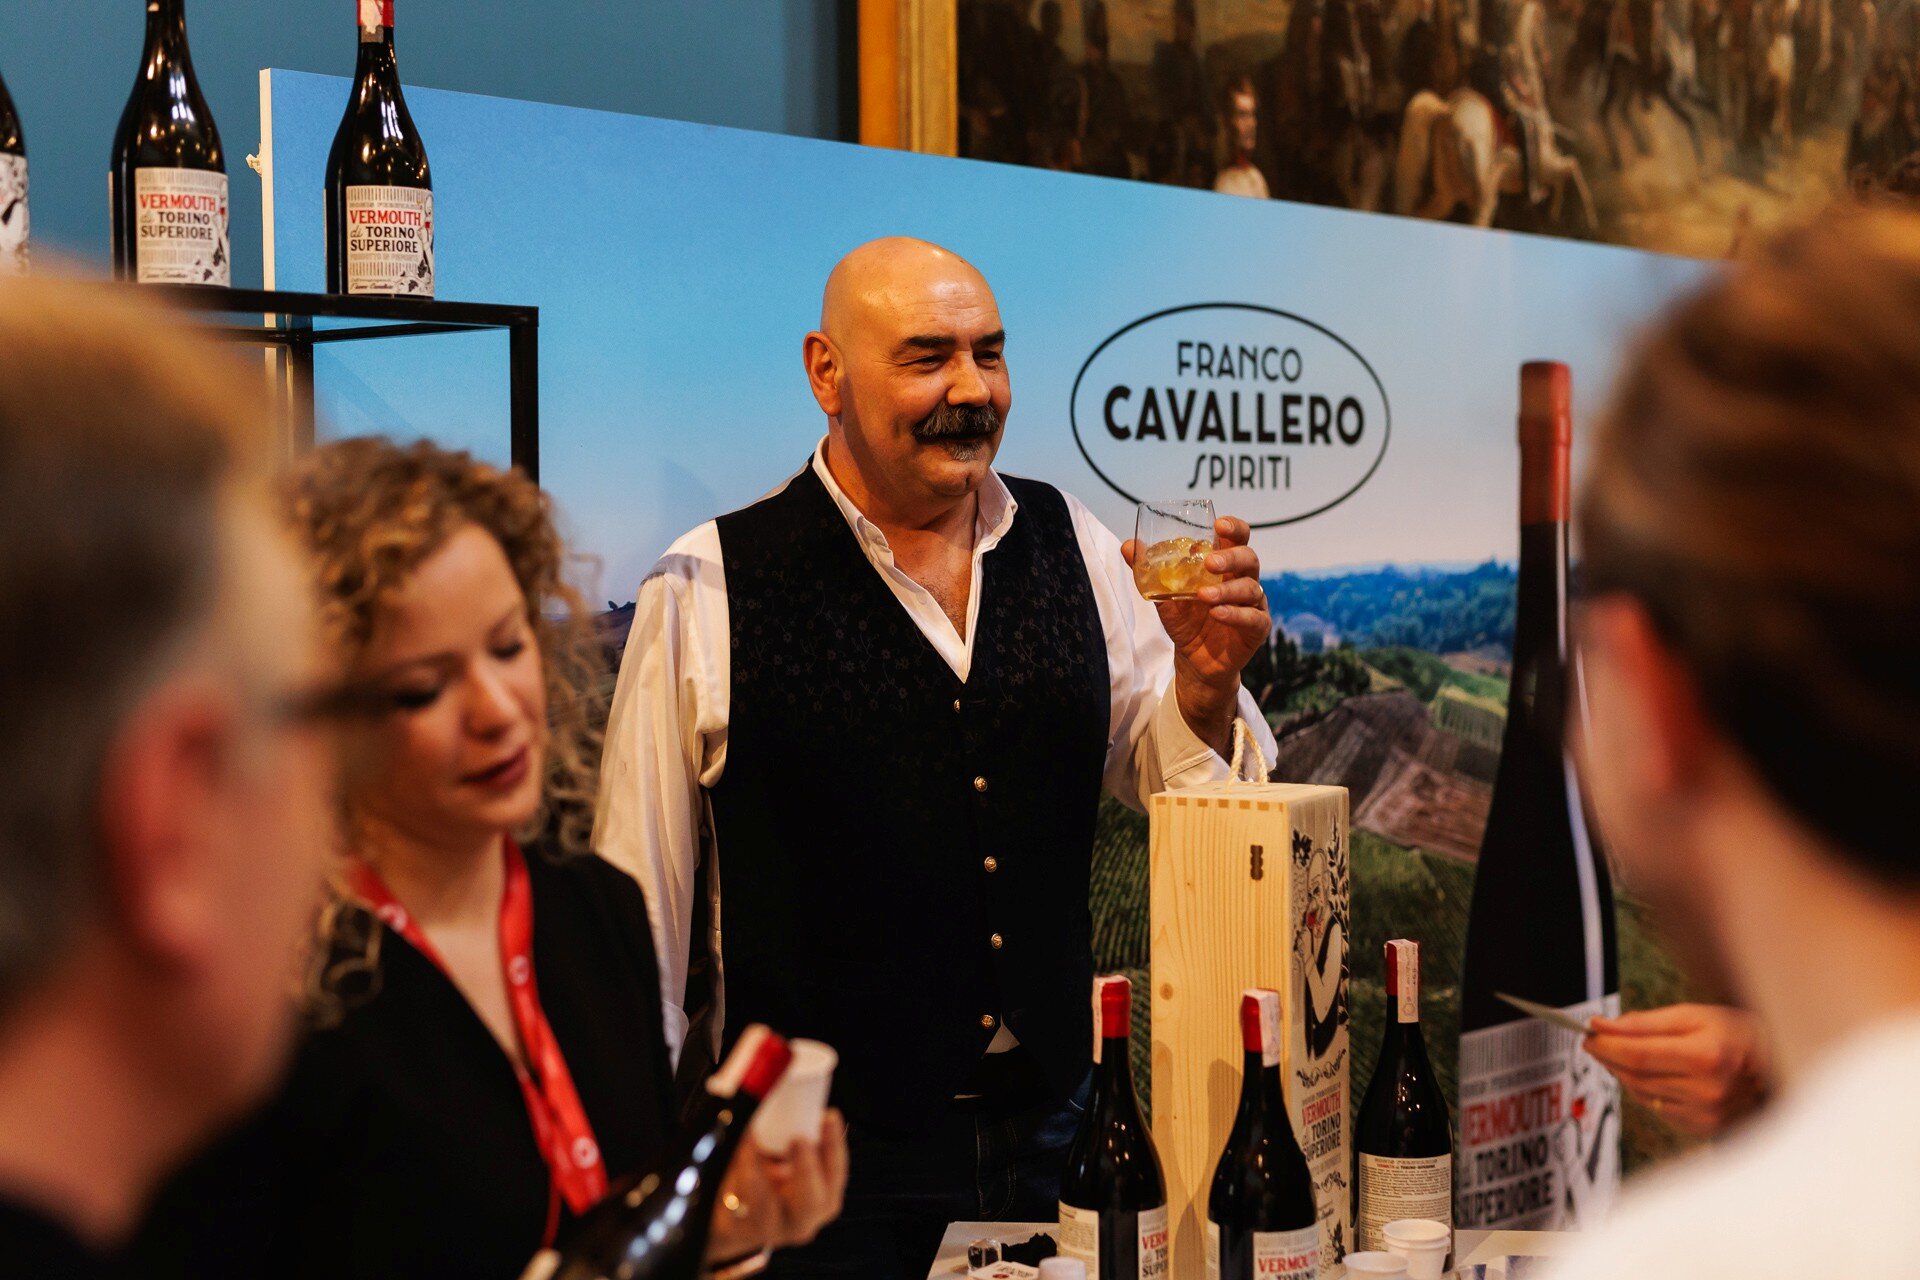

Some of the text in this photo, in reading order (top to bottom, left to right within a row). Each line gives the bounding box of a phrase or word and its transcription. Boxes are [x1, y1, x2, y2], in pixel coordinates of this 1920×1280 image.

[139, 193, 216, 212] VERMOUTH
[158, 211, 210, 225] TORINO
[349, 209, 421, 226] VERMOUTH
[140, 225, 213, 240] SUPERIORE
[350, 225, 415, 239] di TORINO
[350, 239, 418, 253] SUPERIORE
[1177, 341, 1302, 382] FRANCO
[1103, 384, 1364, 445] CAVALLERO
[1187, 454, 1291, 490] SPIRITI
[1301, 1089, 1341, 1127] VERMOUTH
[1311, 1112, 1341, 1141] TORINO
[1476, 1132, 1550, 1185] TORINO
